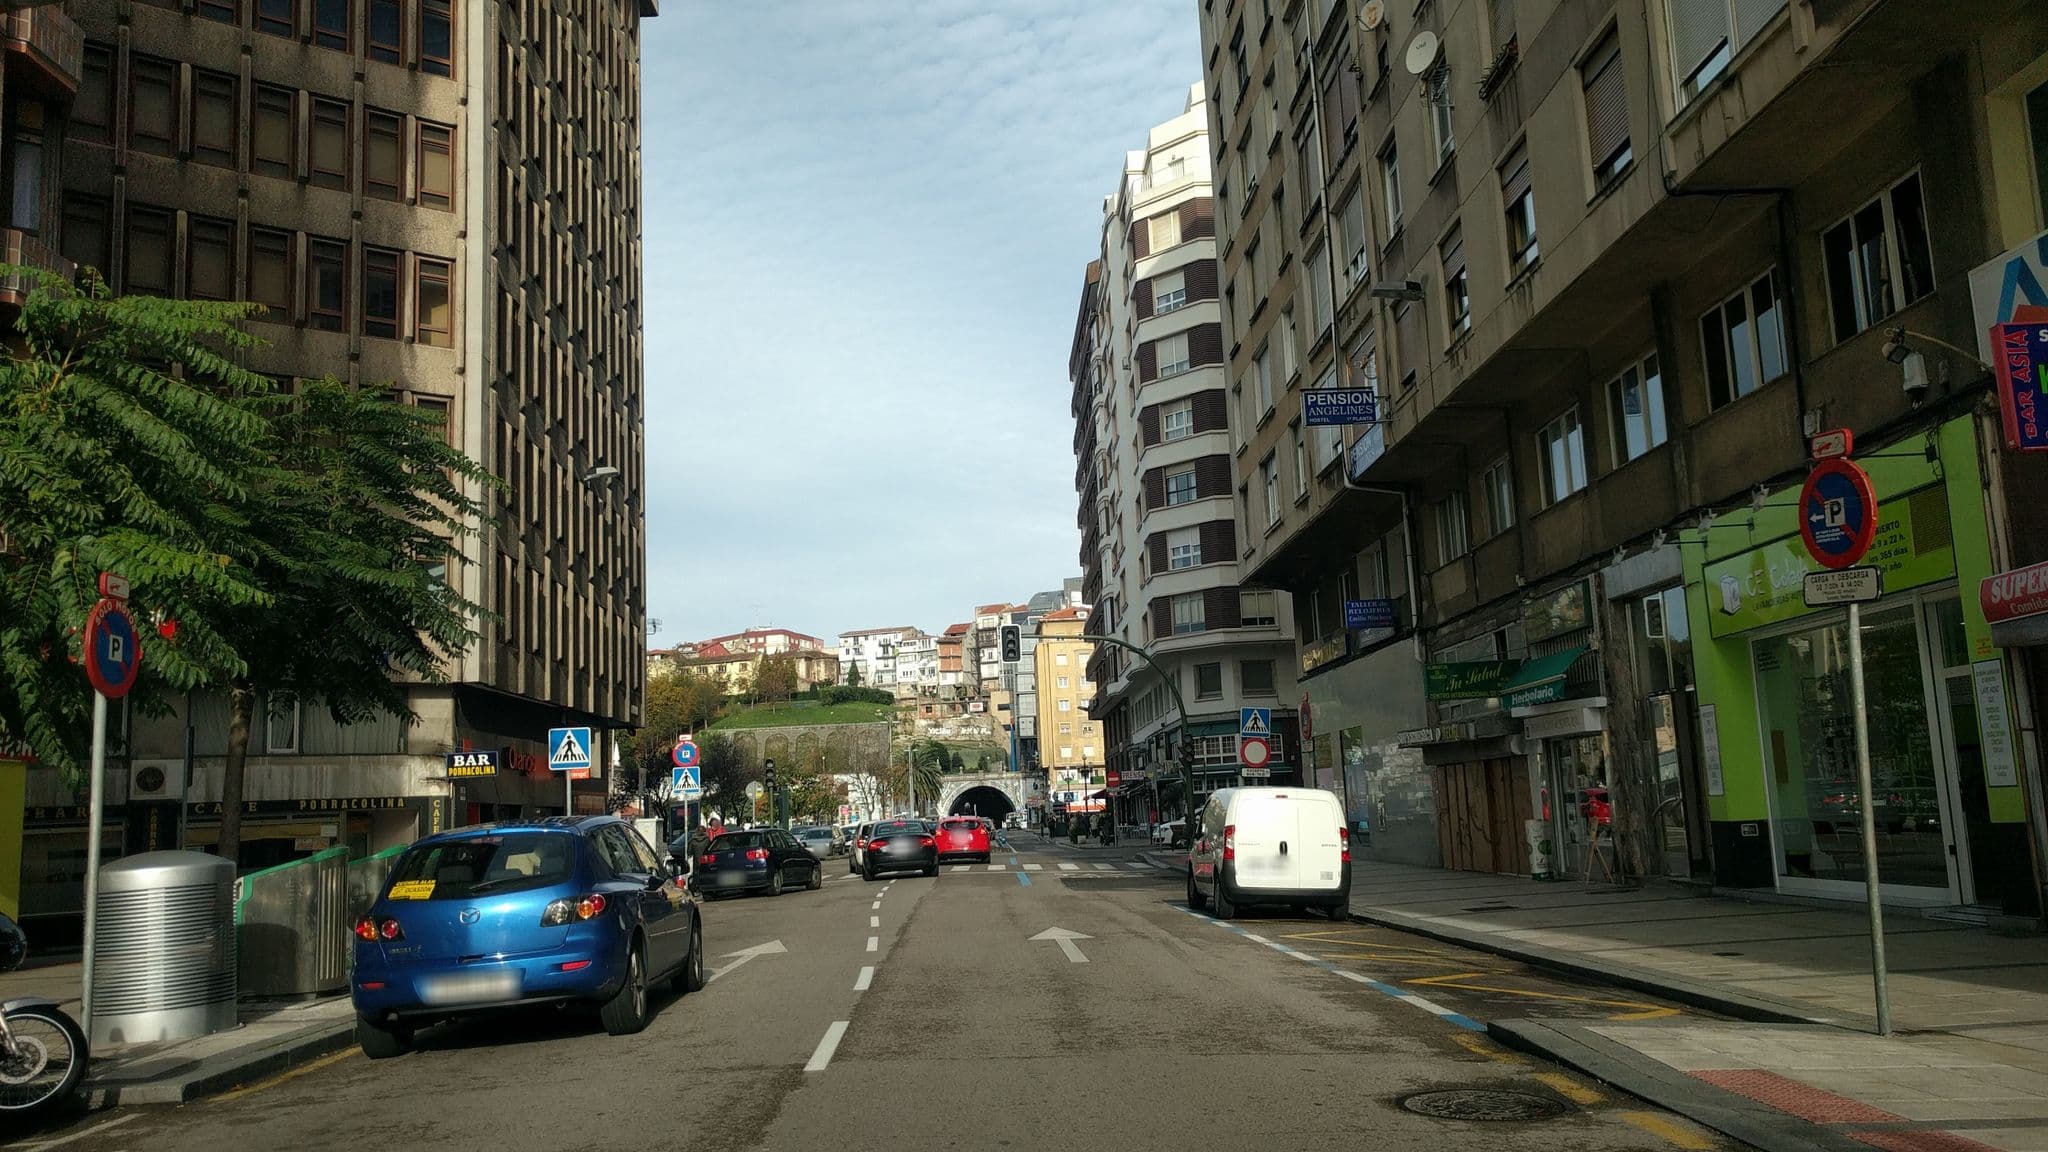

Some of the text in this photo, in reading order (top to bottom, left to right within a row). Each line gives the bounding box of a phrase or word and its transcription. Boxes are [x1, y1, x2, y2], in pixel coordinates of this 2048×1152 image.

[2003, 328, 2037, 439] BAR ASIA
[1307, 393, 1373, 405] PENSION
[1308, 405, 1373, 416] ANGELINES
[1830, 501, 1841, 523] P
[1810, 575, 1829, 584] CARGA
[1838, 571, 1869, 582] DESCARGA
[95, 601, 113, 626] SOLO
[112, 642, 121, 658] P
[1465, 661, 1503, 687] Salud
[1511, 685, 1554, 705] Herbolario
[453, 754, 490, 767] BAR
[448, 765, 496, 777] PORRACOLINA
[1121, 771, 1145, 780] PRENSA
[194, 797, 405, 814] CAE PORRACOLINA
